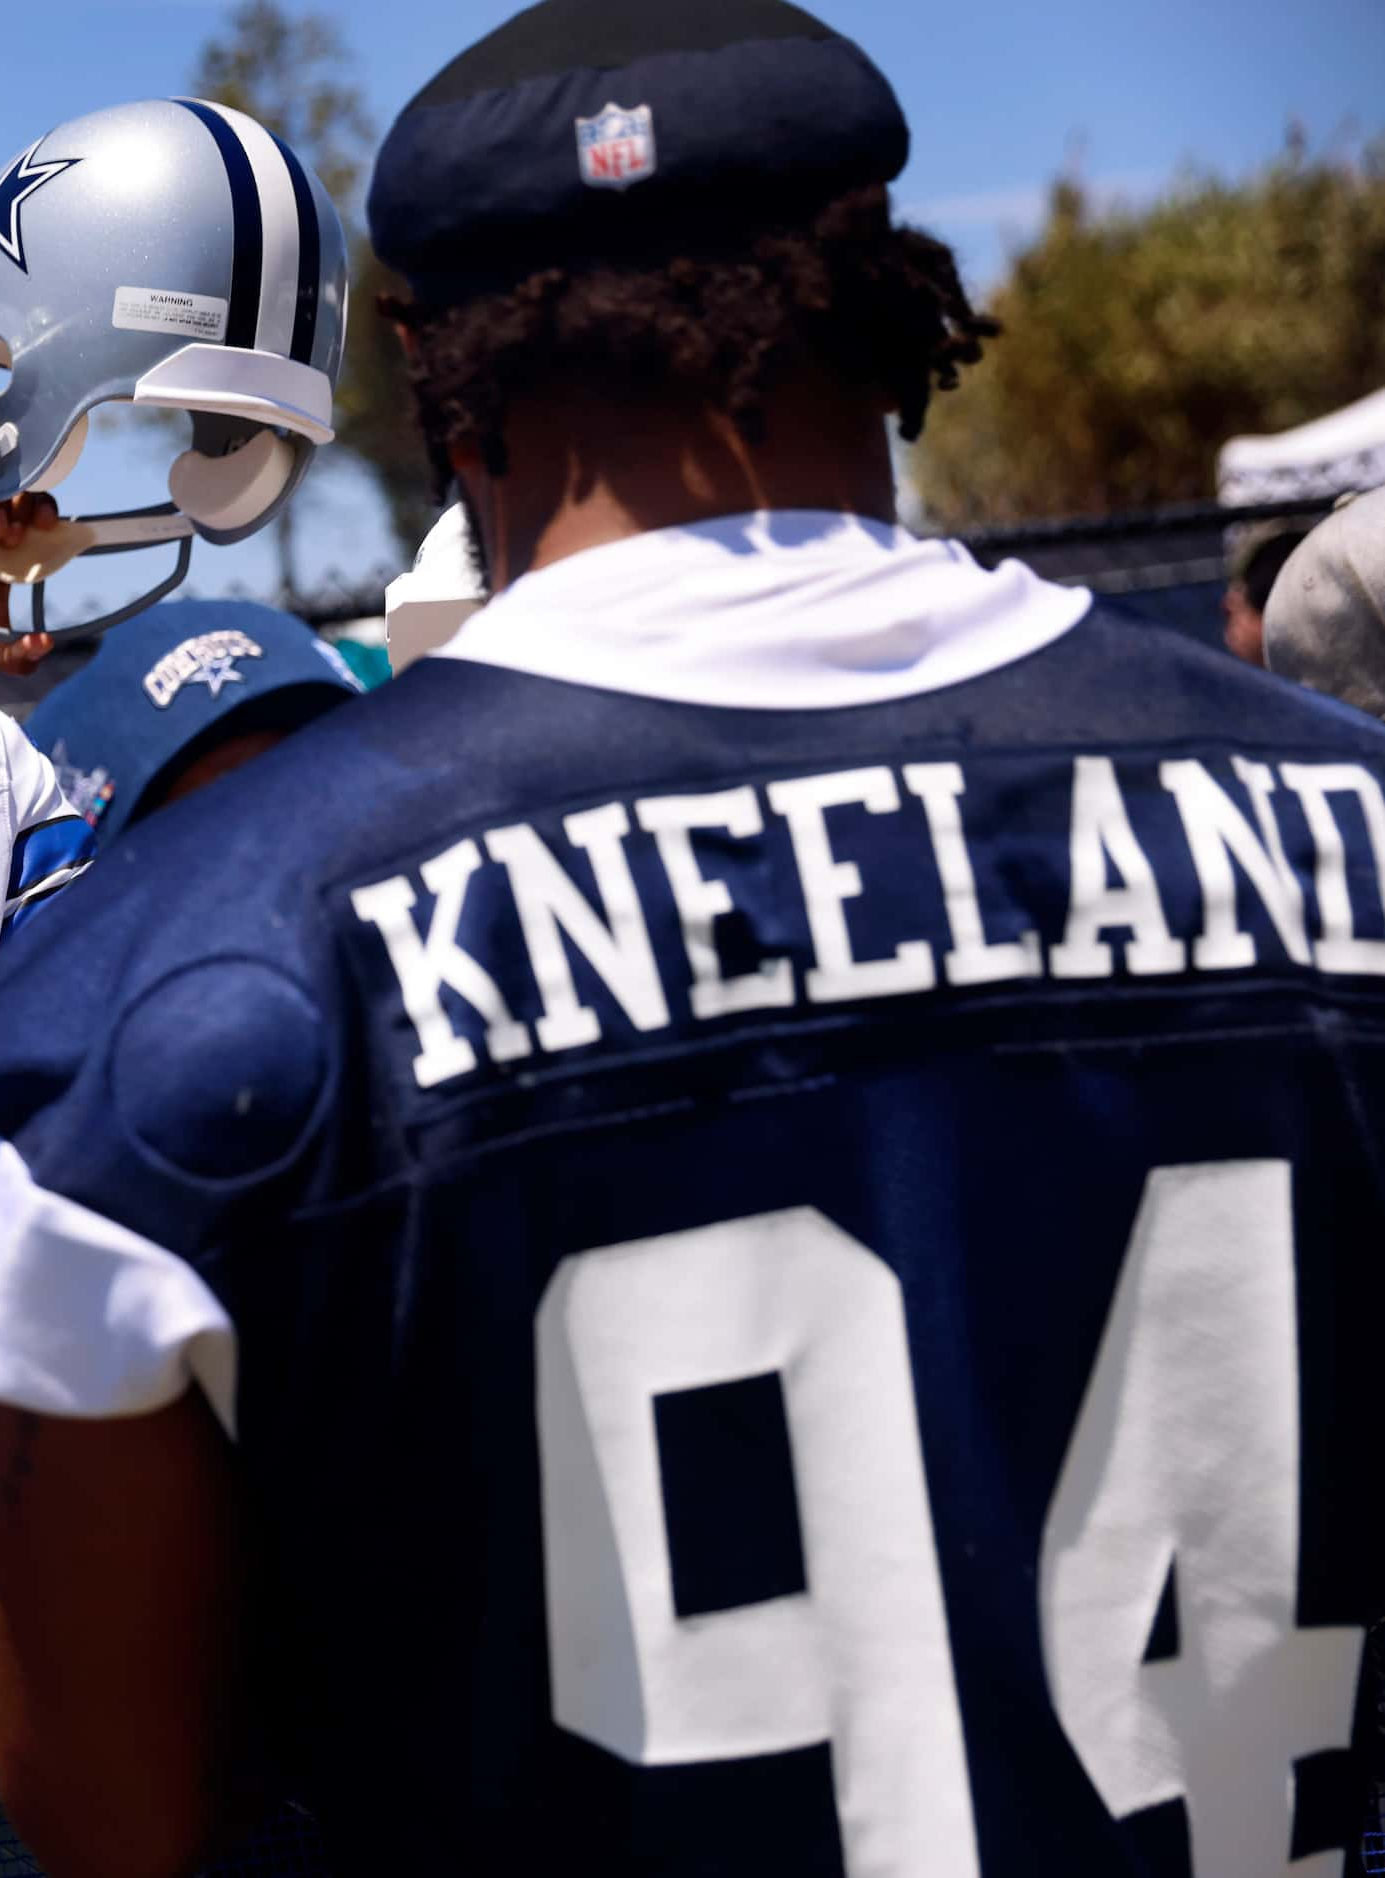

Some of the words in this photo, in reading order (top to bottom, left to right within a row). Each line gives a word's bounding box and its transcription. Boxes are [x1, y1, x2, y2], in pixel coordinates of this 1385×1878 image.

[587, 138, 648, 178] NFL
[150, 295, 193, 307] WARNING
[350, 755, 1385, 1088] KNEELAND
[535, 1158, 1365, 1878] 94
